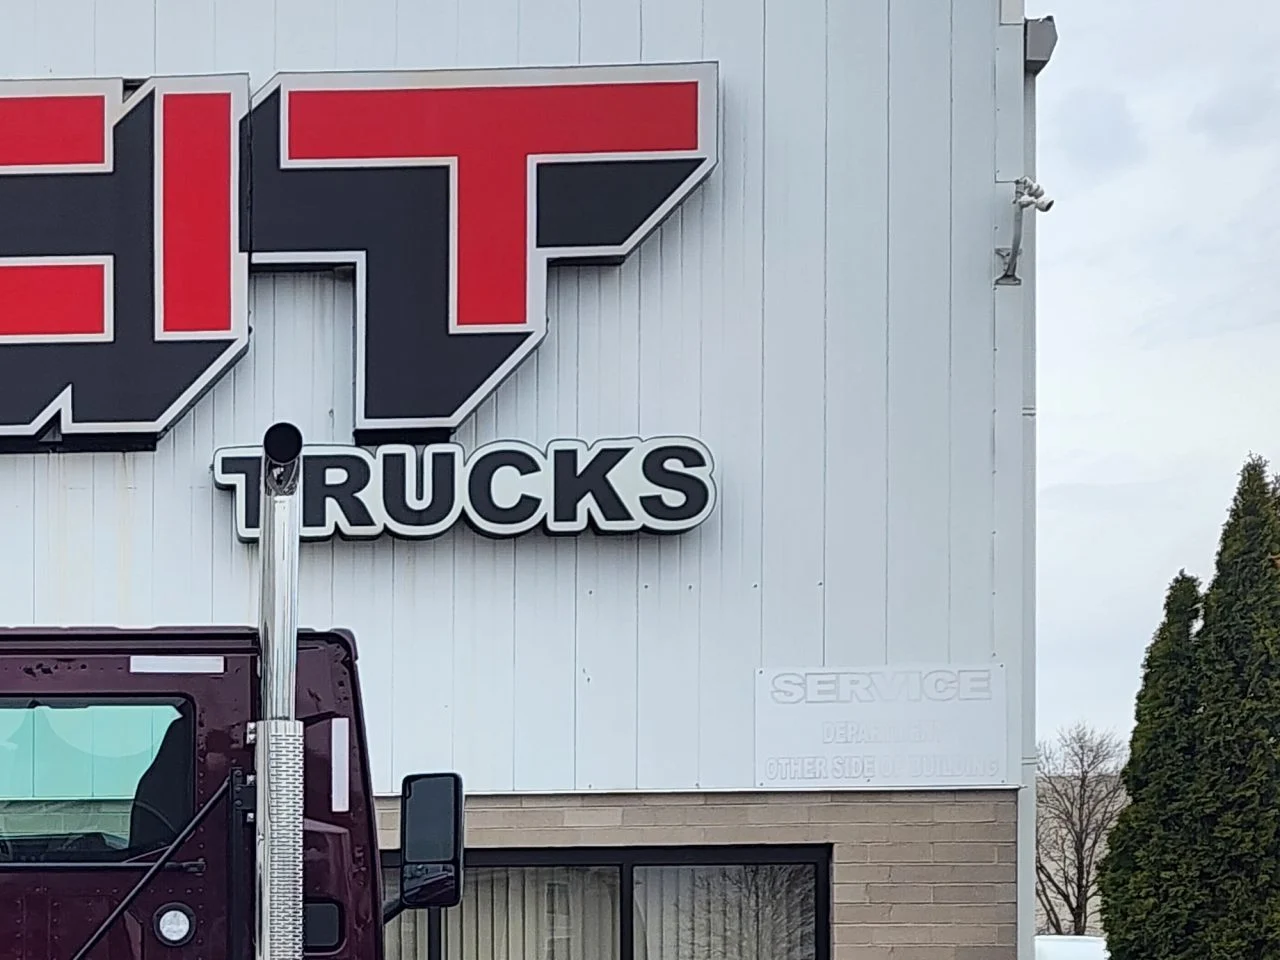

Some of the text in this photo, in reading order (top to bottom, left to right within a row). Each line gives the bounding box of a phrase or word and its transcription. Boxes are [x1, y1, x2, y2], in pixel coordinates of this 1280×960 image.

[770, 669, 992, 704] SERVICE
[765, 756, 829, 780] OTHER
[831, 755, 877, 780] SIDE
